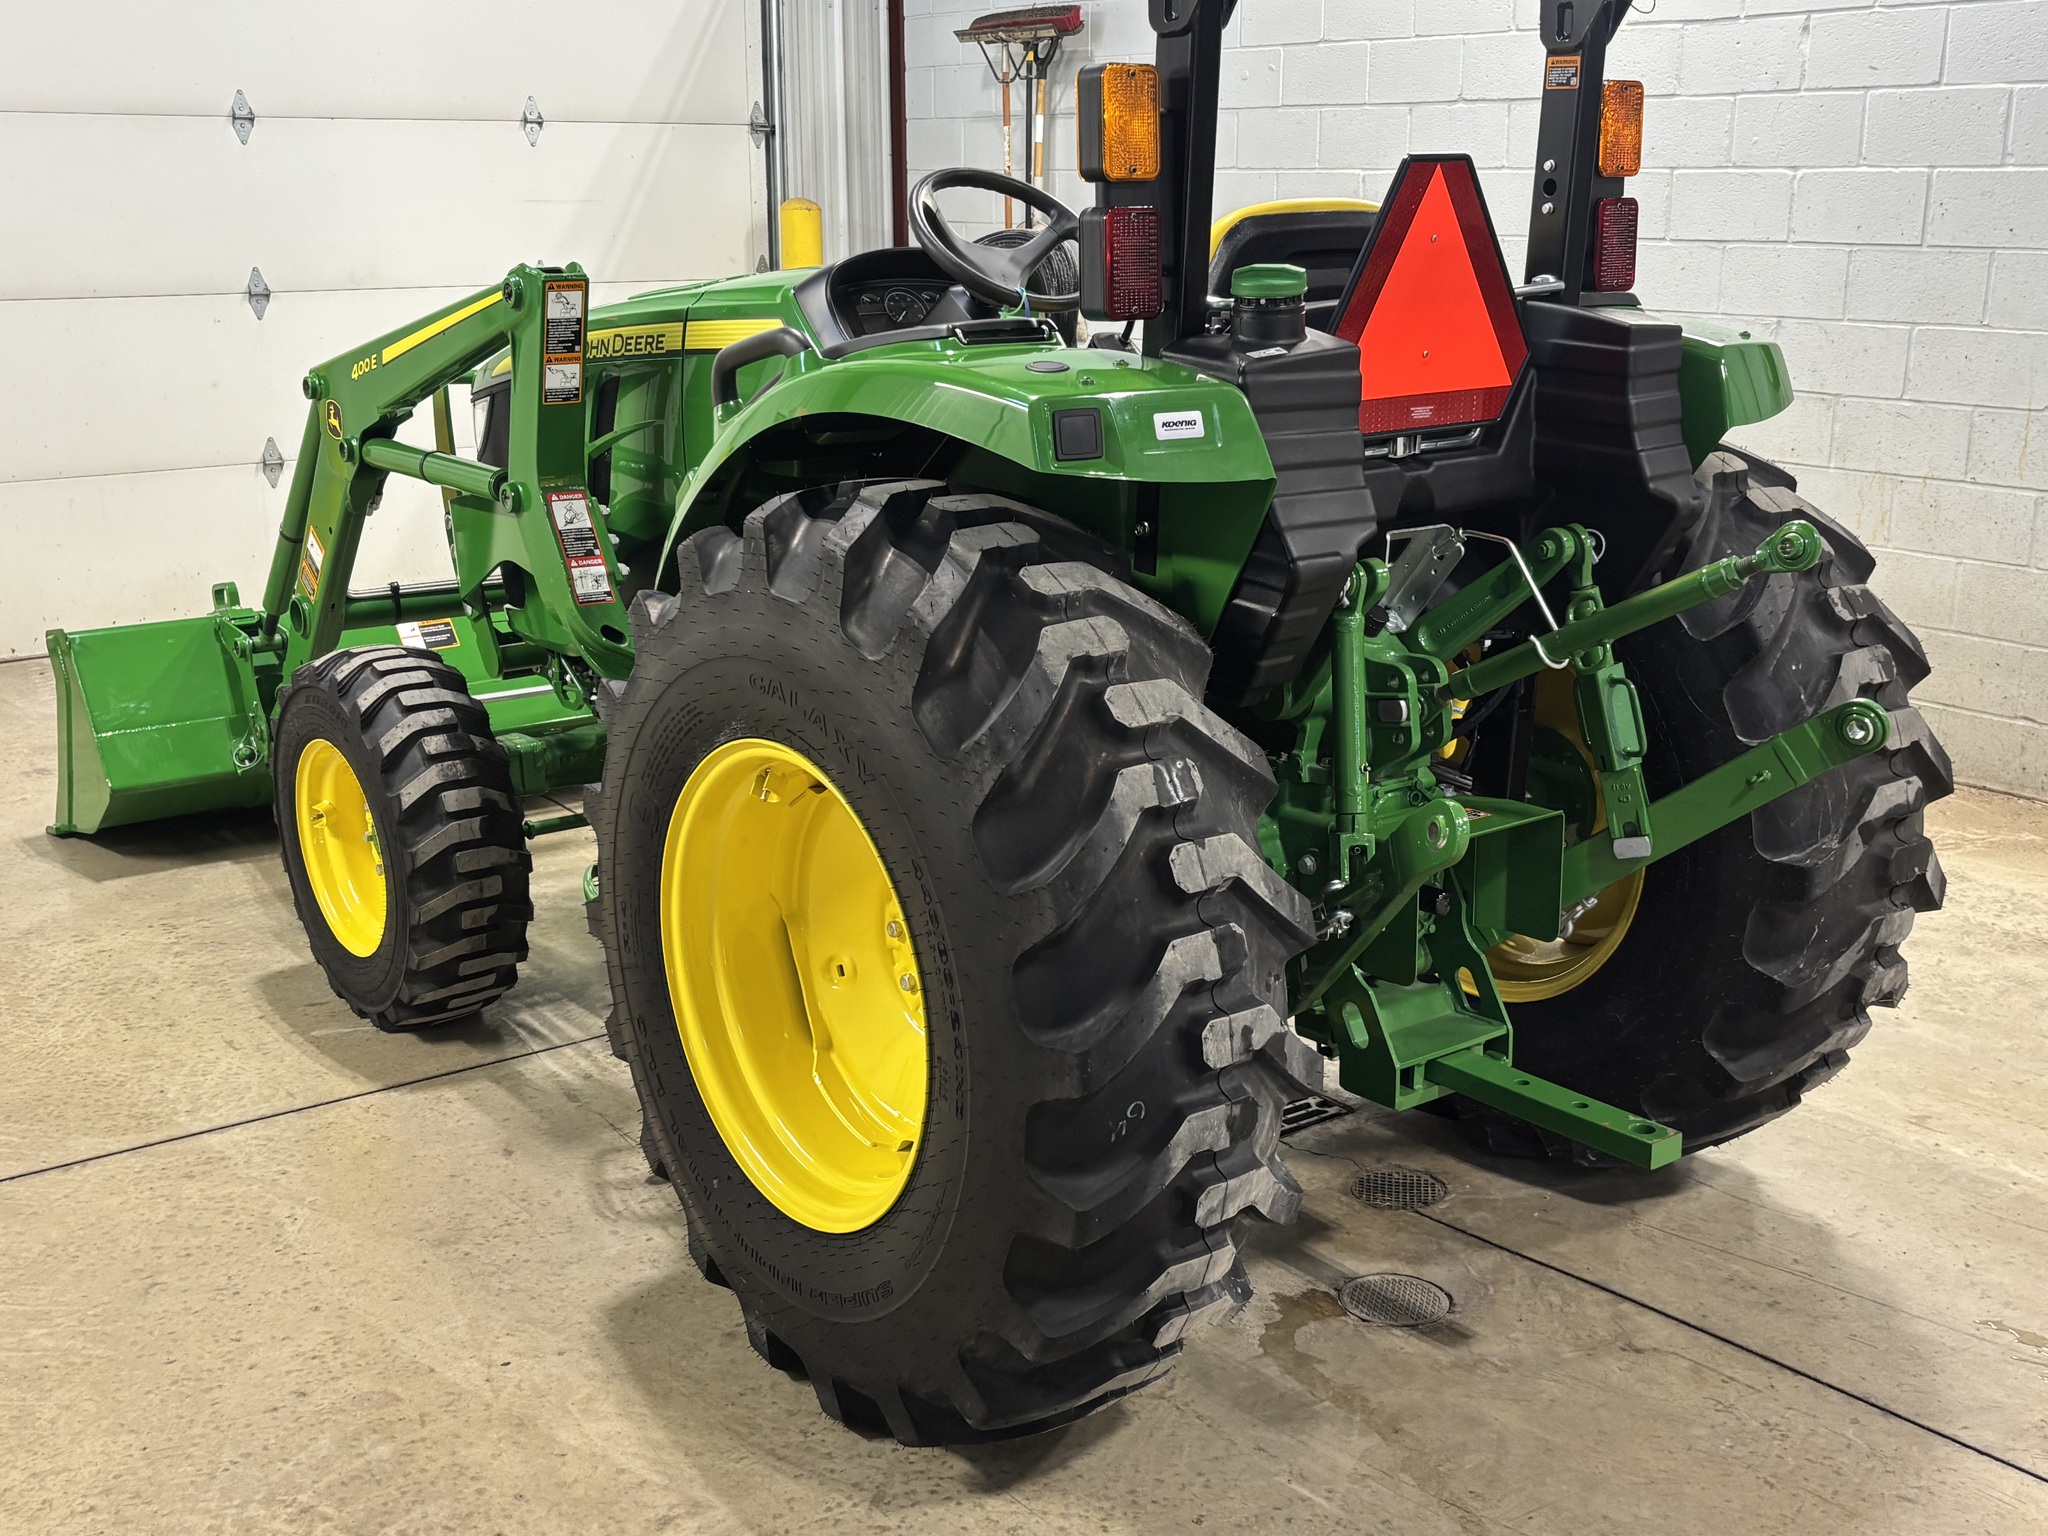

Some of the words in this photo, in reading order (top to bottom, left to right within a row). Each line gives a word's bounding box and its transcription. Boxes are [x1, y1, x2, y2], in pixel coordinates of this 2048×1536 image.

[611, 333, 667, 355] DEERE
[559, 492, 583, 500] DANGER
[578, 558, 603, 567] DANGER
[809, 1278, 895, 1309] SUPER
